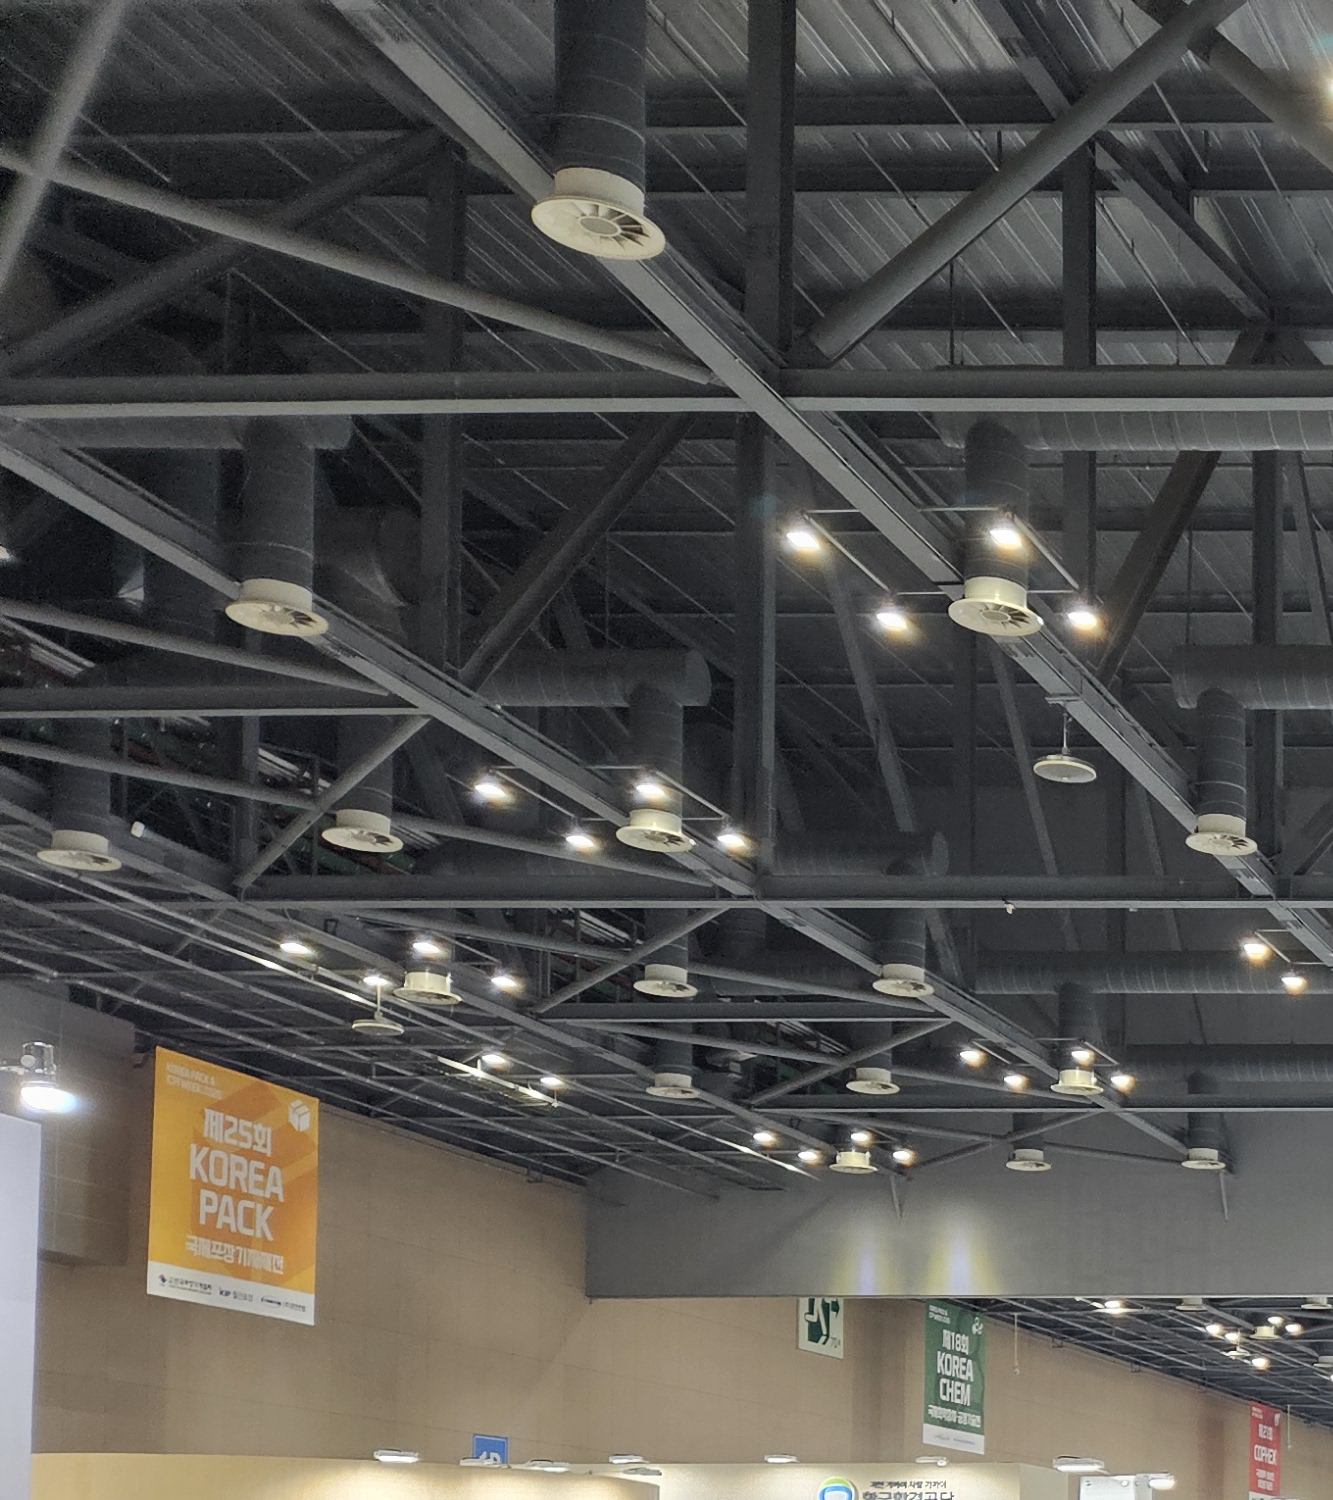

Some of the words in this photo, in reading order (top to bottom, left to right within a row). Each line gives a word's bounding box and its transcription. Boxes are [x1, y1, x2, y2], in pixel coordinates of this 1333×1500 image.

[204, 1108, 272, 1157] 제25회
[189, 1143, 284, 1203] KOREA
[199, 1188, 275, 1242] PACK
[936, 1350, 974, 1382] KOREA
[939, 1378, 971, 1407] CHEM
